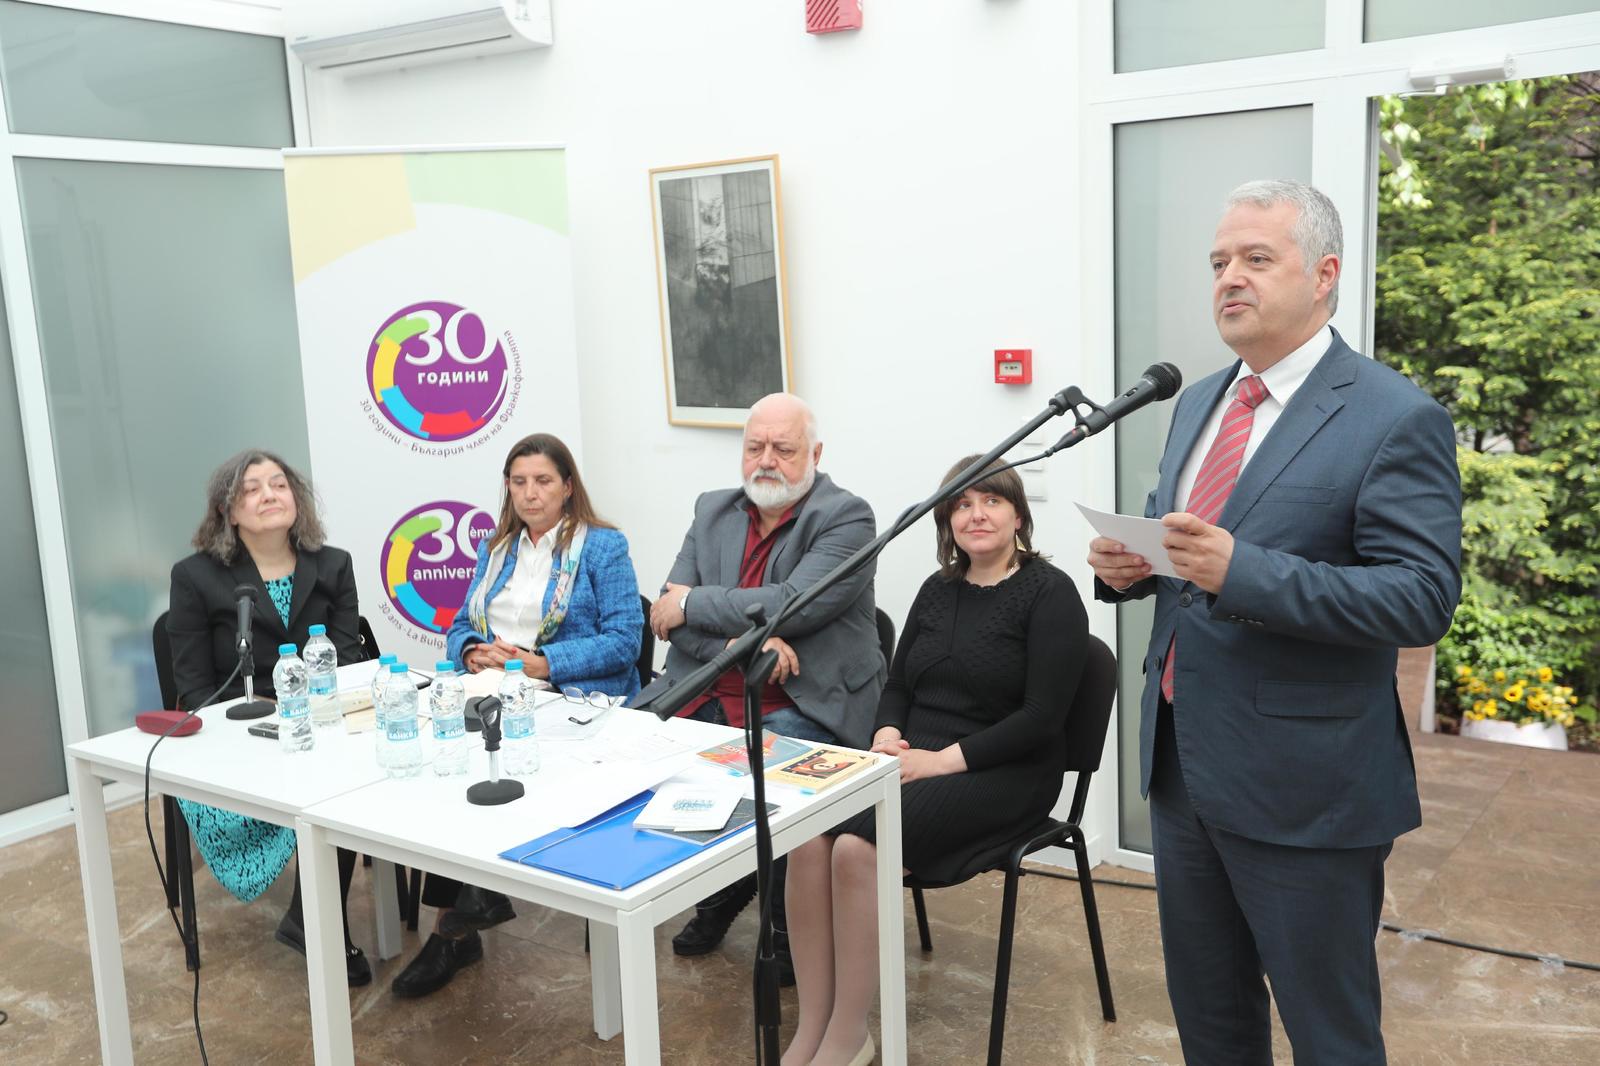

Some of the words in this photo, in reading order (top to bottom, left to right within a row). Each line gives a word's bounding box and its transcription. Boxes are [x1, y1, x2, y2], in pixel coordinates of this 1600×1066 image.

[404, 308, 498, 366] 30
[417, 370, 490, 387] години
[359, 398, 373, 412] 30
[368, 413, 402, 445] години
[411, 442, 465, 459] България
[466, 433, 491, 450] член
[491, 424, 503, 437] на
[377, 601, 391, 614] 30
[388, 614, 404, 630] ans
[406, 627, 419, 640] La
